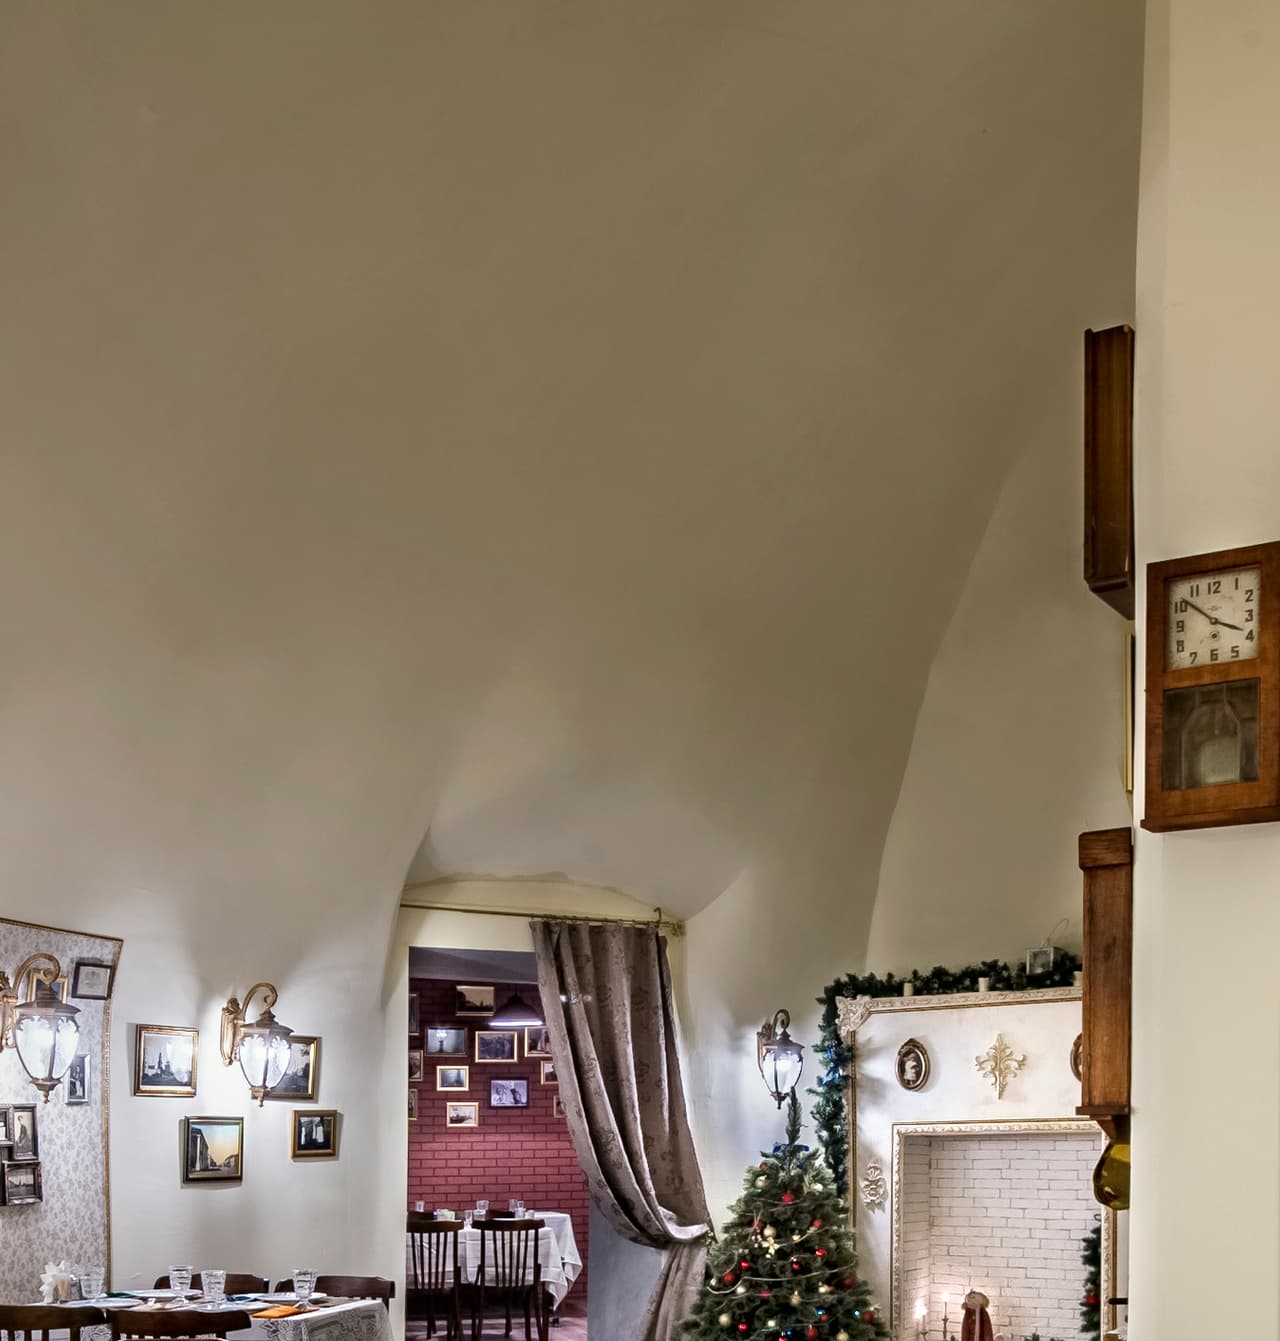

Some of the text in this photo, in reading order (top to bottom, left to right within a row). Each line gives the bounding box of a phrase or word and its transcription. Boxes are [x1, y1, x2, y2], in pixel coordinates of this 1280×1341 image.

[1190, 584, 1199, 598] 11
[1207, 581, 1221, 595] 12
[1245, 589, 1254, 602] 2
[1174, 600, 1188, 614] 10
[1245, 609, 1254, 622] 3
[1176, 620, 1184, 633] 9
[1245, 629, 1254, 642] 4
[1176, 640, 1184, 653] 8
[1231, 645, 1240, 658] 5
[1190, 652, 1197, 664] 7
[1210, 649, 1218, 661] 6
